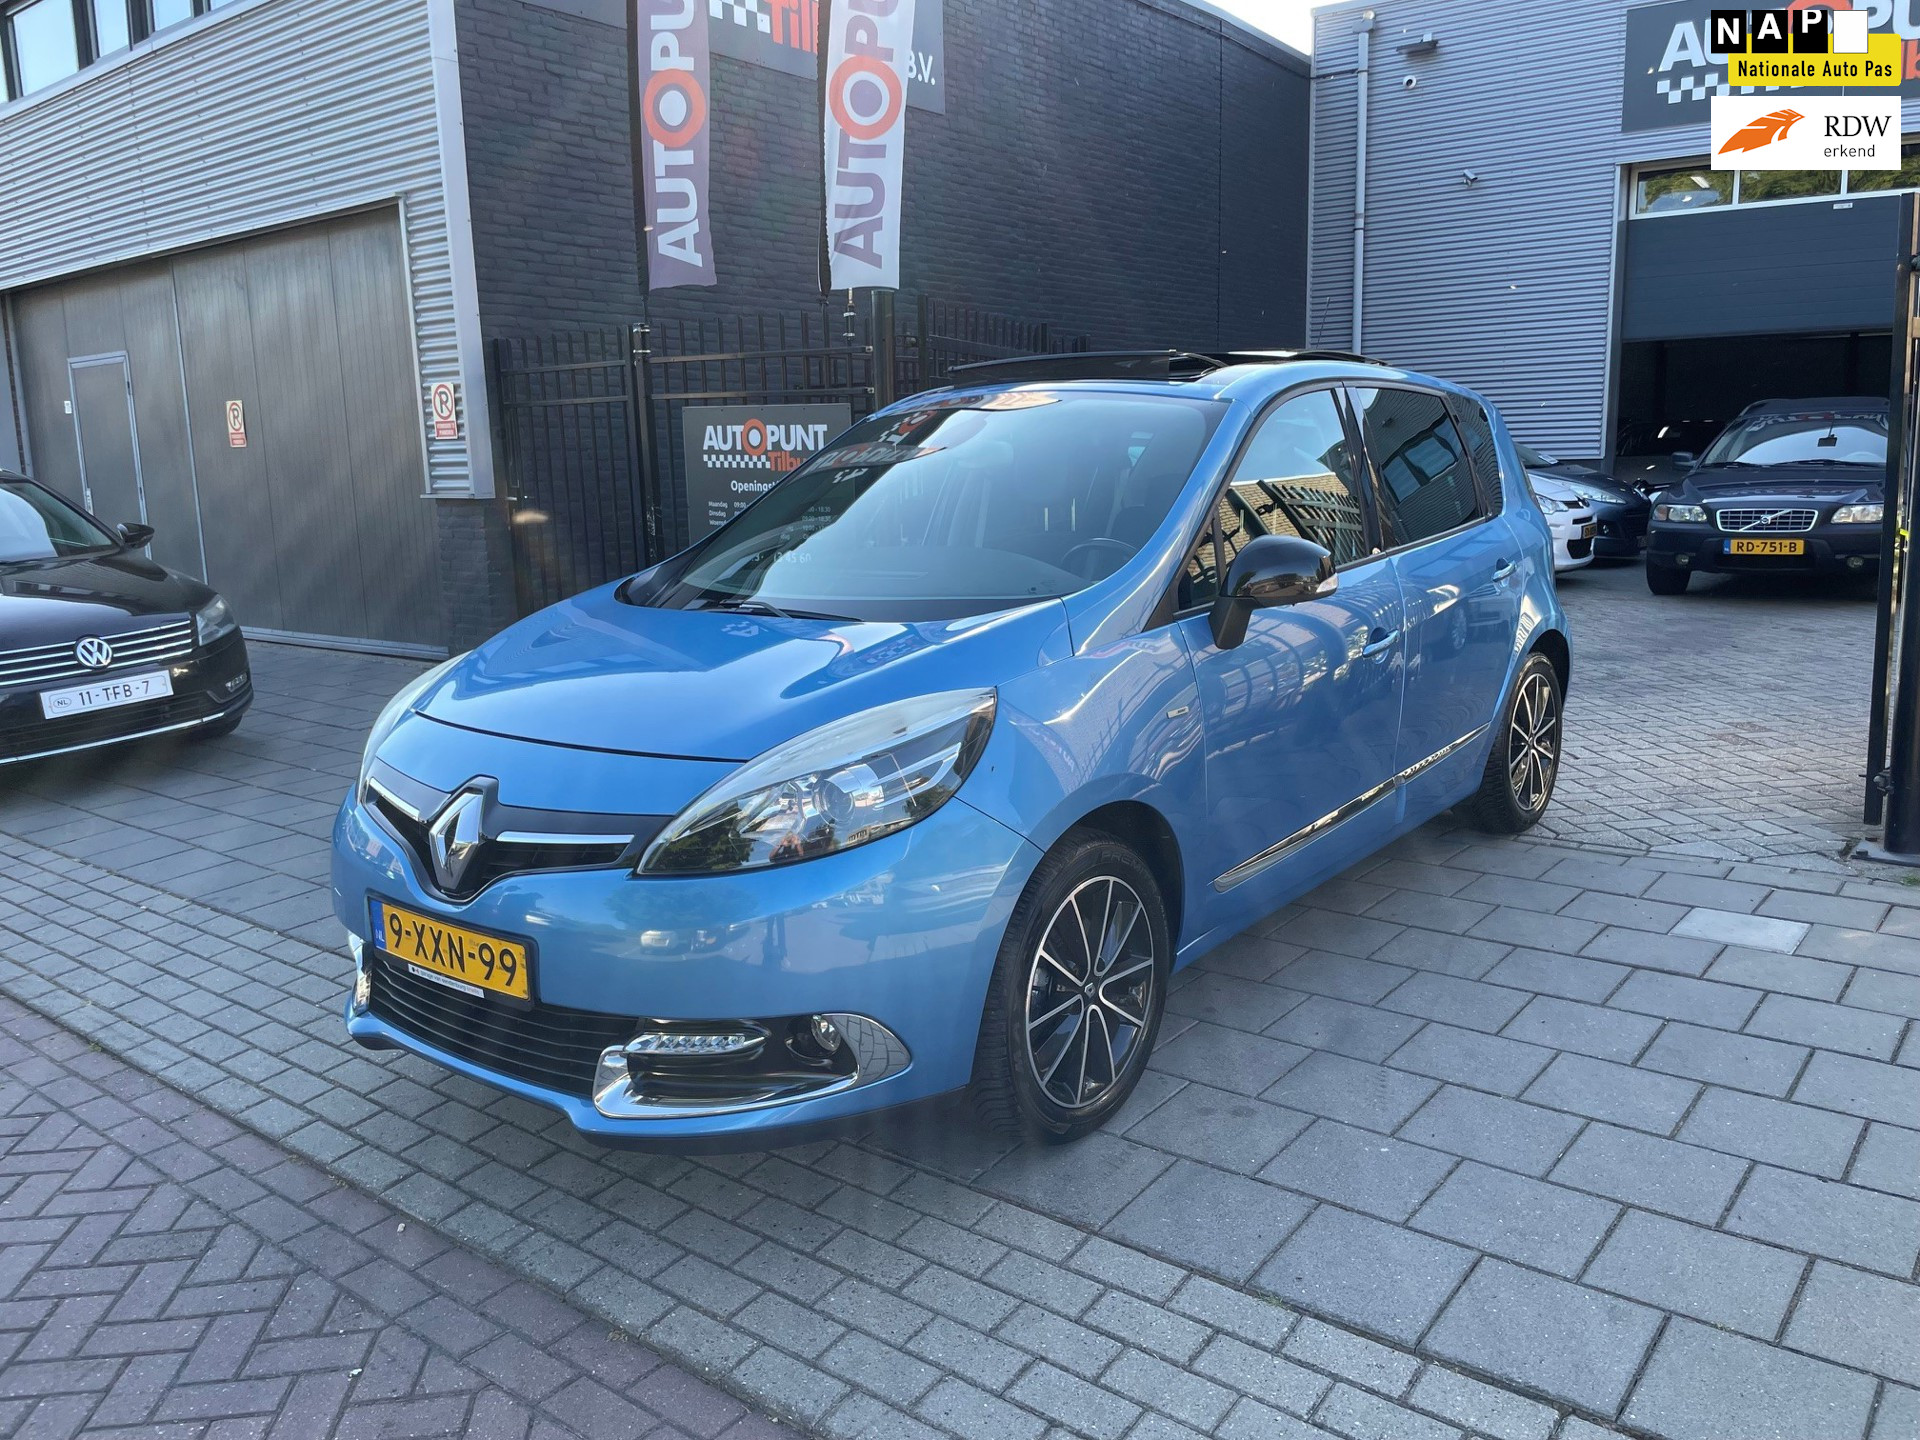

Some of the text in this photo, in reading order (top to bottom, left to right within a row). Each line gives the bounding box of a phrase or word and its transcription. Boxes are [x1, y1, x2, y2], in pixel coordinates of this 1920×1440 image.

[703, 418, 828, 457] AUTOPUNT
[708, 501, 728, 509] Maandag
[1736, 541, 1797, 553] RD-751-B
[57, 681, 150, 707] NL 11-TFB-7
[389, 912, 517, 987] 9-XXN-99
